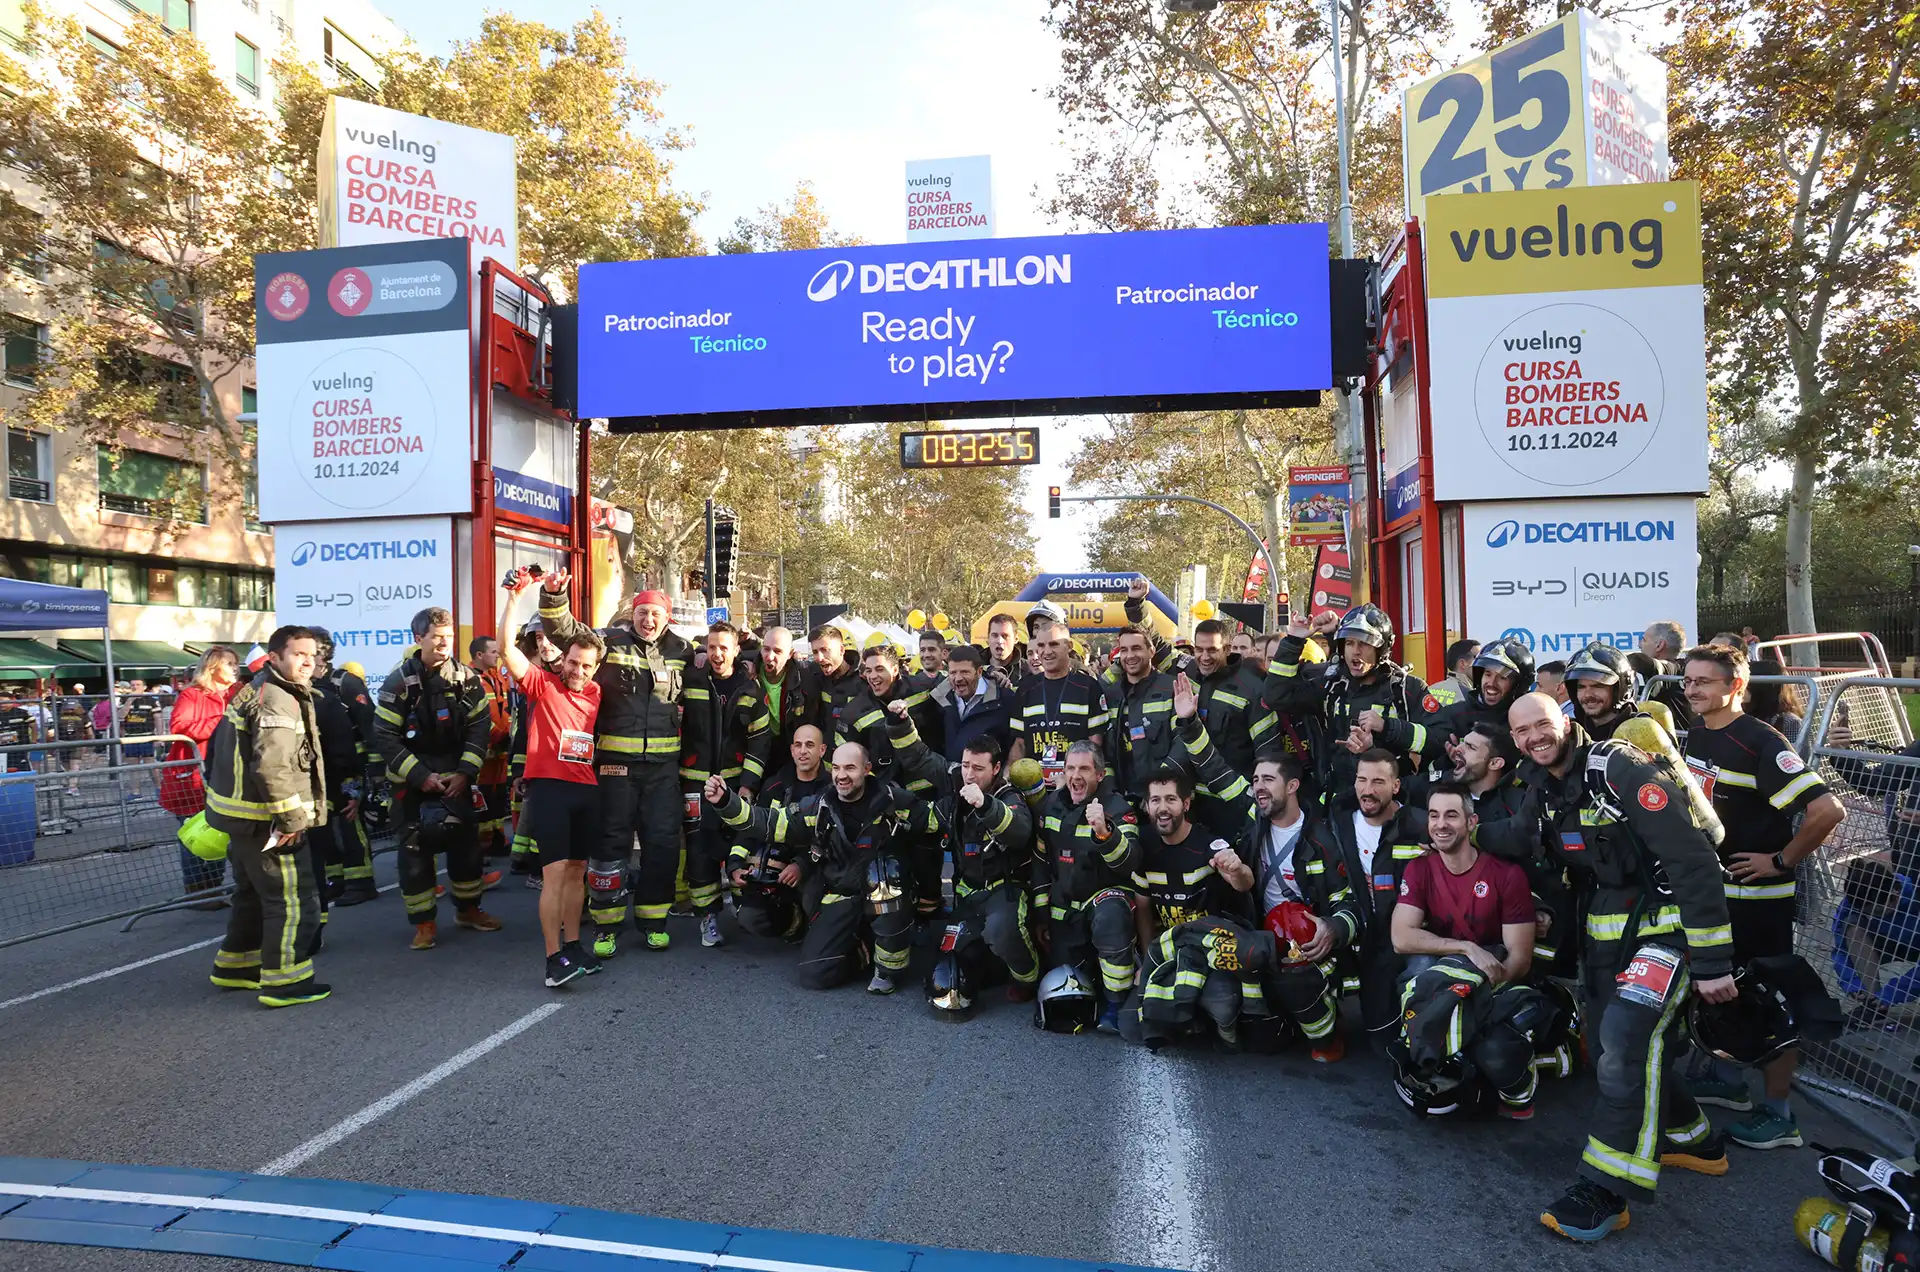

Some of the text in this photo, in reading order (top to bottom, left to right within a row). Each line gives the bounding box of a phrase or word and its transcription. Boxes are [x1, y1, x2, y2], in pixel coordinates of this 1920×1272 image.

[1417, 22, 1571, 197] 25
[1591, 78, 1635, 124] CURSA
[1593, 104, 1653, 161] BOMBERS
[345, 127, 436, 164] vueling
[346, 154, 436, 190] CURSA
[908, 174, 952, 188] vueling
[347, 178, 477, 219] BOMBERS
[908, 190, 951, 204] CURSA
[908, 202, 972, 217] BOMBERS
[347, 203, 507, 248] BARCELONA
[908, 214, 988, 231] BARCELONA
[1450, 204, 1663, 270] vueling
[380, 273, 442, 288] Ajuntament de
[859, 253, 1072, 295] DECATHLON
[380, 284, 442, 301] Barcelona
[1116, 281, 1259, 305] Patrocinador
[604, 309, 732, 333] Patrocinador
[861, 307, 976, 347] Ready
[1212, 308, 1299, 329] Técnico
[690, 334, 767, 354] Técnico
[1503, 329, 1582, 355] vueling
[888, 340, 1015, 386] to play?
[1503, 359, 1582, 383] CURSA
[312, 371, 374, 393] vueling
[1505, 380, 1620, 405] BOMBERS
[312, 397, 373, 418] CURSA
[1506, 402, 1649, 428] BARCELONA
[312, 416, 403, 438] BOMBERS
[313, 435, 424, 458] BARCELONA
[922, 431, 1034, 463] 08:32:55
[1507, 430, 1618, 452] 10.11.2024
[314, 460, 400, 479] 10.11.2024
[503, 481, 560, 512] DECATHLON
[1524, 520, 1675, 544] DECATHLON
[320, 538, 437, 562] DECATHLON
[1064, 577, 1132, 589] DECATHLON
[1492, 571, 1670, 596] BYD QUADIS
[44, 602, 101, 613] timingsense
[296, 584, 433, 609] BYD QUADIS
[1583, 592, 1616, 602] Dream
[333, 630, 372, 647] NTT
[1541, 632, 1593, 653] NTT
